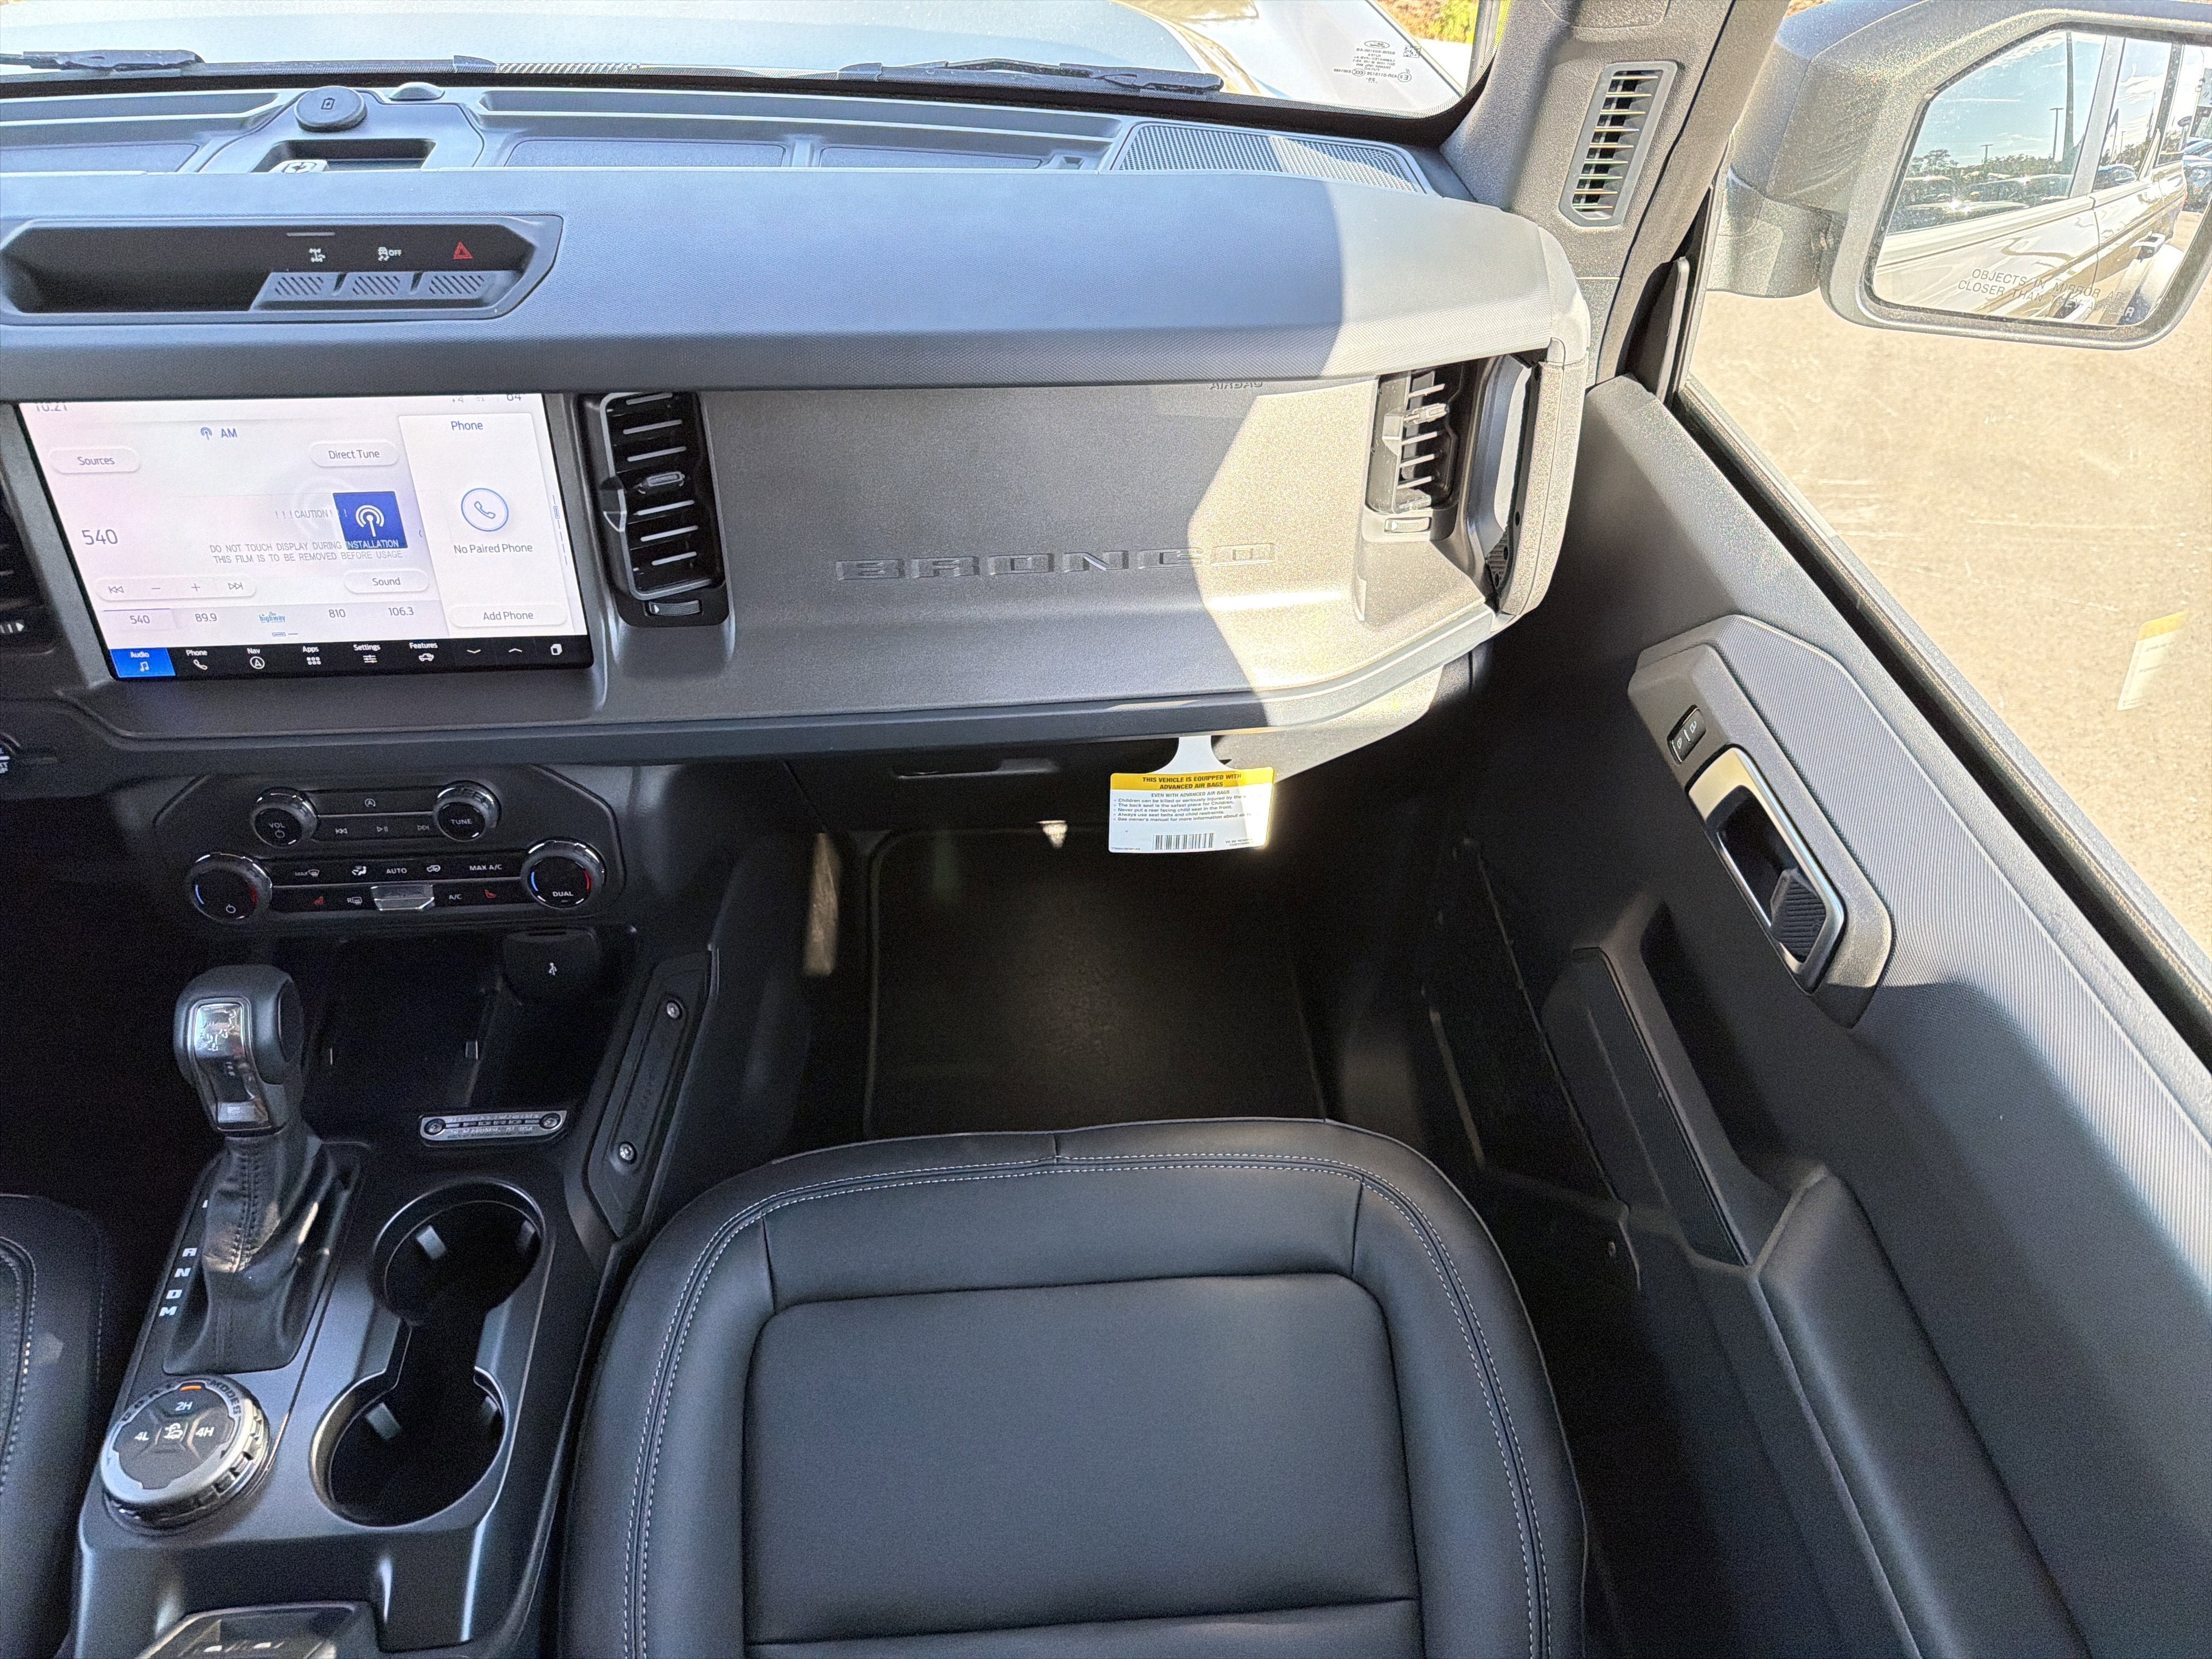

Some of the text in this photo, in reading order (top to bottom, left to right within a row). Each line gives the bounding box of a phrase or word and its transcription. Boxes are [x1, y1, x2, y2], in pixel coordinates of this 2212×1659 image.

[1971, 268, 2027, 286] OBJECTS
[2033, 280, 2046, 289] IN
[2053, 282, 2101, 298] MIRROR
[1958, 280, 2005, 296] CLOSER
[2012, 289, 2046, 302] THAN
[450, 420, 483, 431] Phone
[221, 428, 238, 438] AM
[328, 449, 380, 460] Direct Tune
[77, 456, 115, 466] Sources
[81, 529, 119, 545] 540
[210, 539, 400, 553] DO NOT TOUCH DISPLAY DURING INSTALLATION
[454, 543, 533, 554] No Paired Phone
[213, 550, 403, 564] THIS FILM IS TO BE REMOVED BEFORE USAGE
[835, 542, 1277, 580] BRONCO
[372, 577, 401, 587] Sound
[329, 608, 346, 618] 810
[388, 607, 414, 617] 106.3
[483, 610, 534, 620] Add Phone
[129, 614, 151, 624] 540
[195, 613, 218, 623] 89.9
[259, 613, 285, 623] highway
[302, 645, 320, 653] Apps
[353, 644, 381, 652] Settings
[409, 641, 438, 650] Features
[185, 648, 208, 657] Phone
[174, 1268, 191, 1278] N
[166, 1289, 183, 1299] D
[159, 1306, 178, 1317] M
[175, 1401, 193, 1412] 2H
[134, 1431, 150, 1441] 4L
[195, 1426, 215, 1437] 4H
